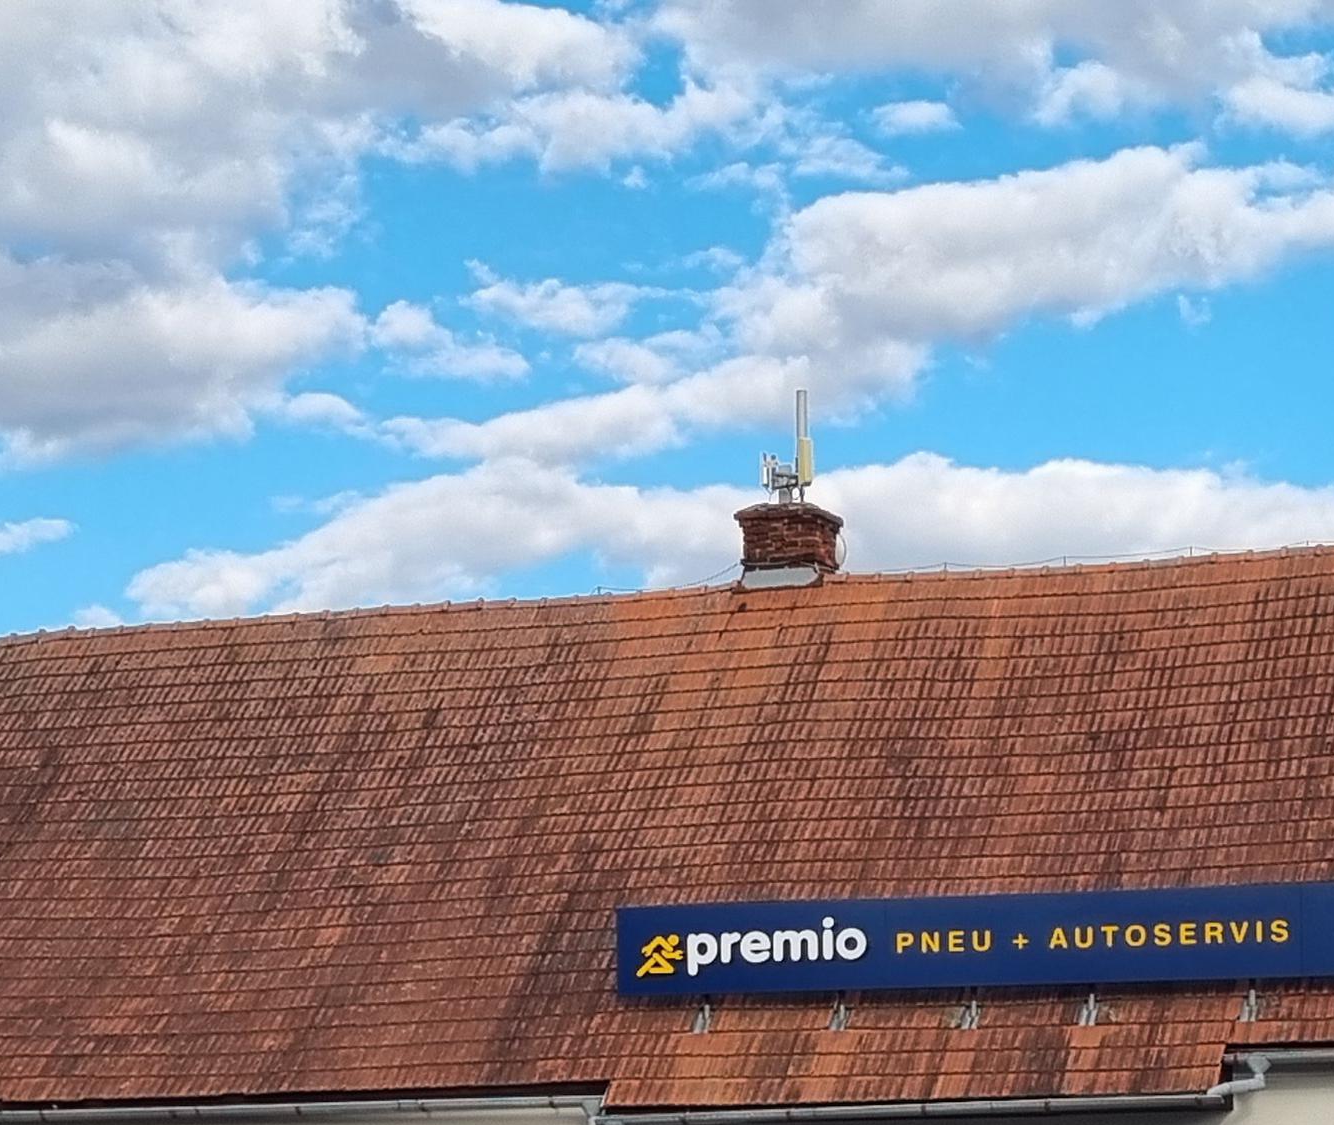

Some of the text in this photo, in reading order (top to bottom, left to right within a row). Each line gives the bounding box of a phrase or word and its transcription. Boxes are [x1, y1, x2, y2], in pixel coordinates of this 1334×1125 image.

[686, 916, 867, 977] premio
[895, 919, 1290, 954] PNEU + AUTOSERVIS
